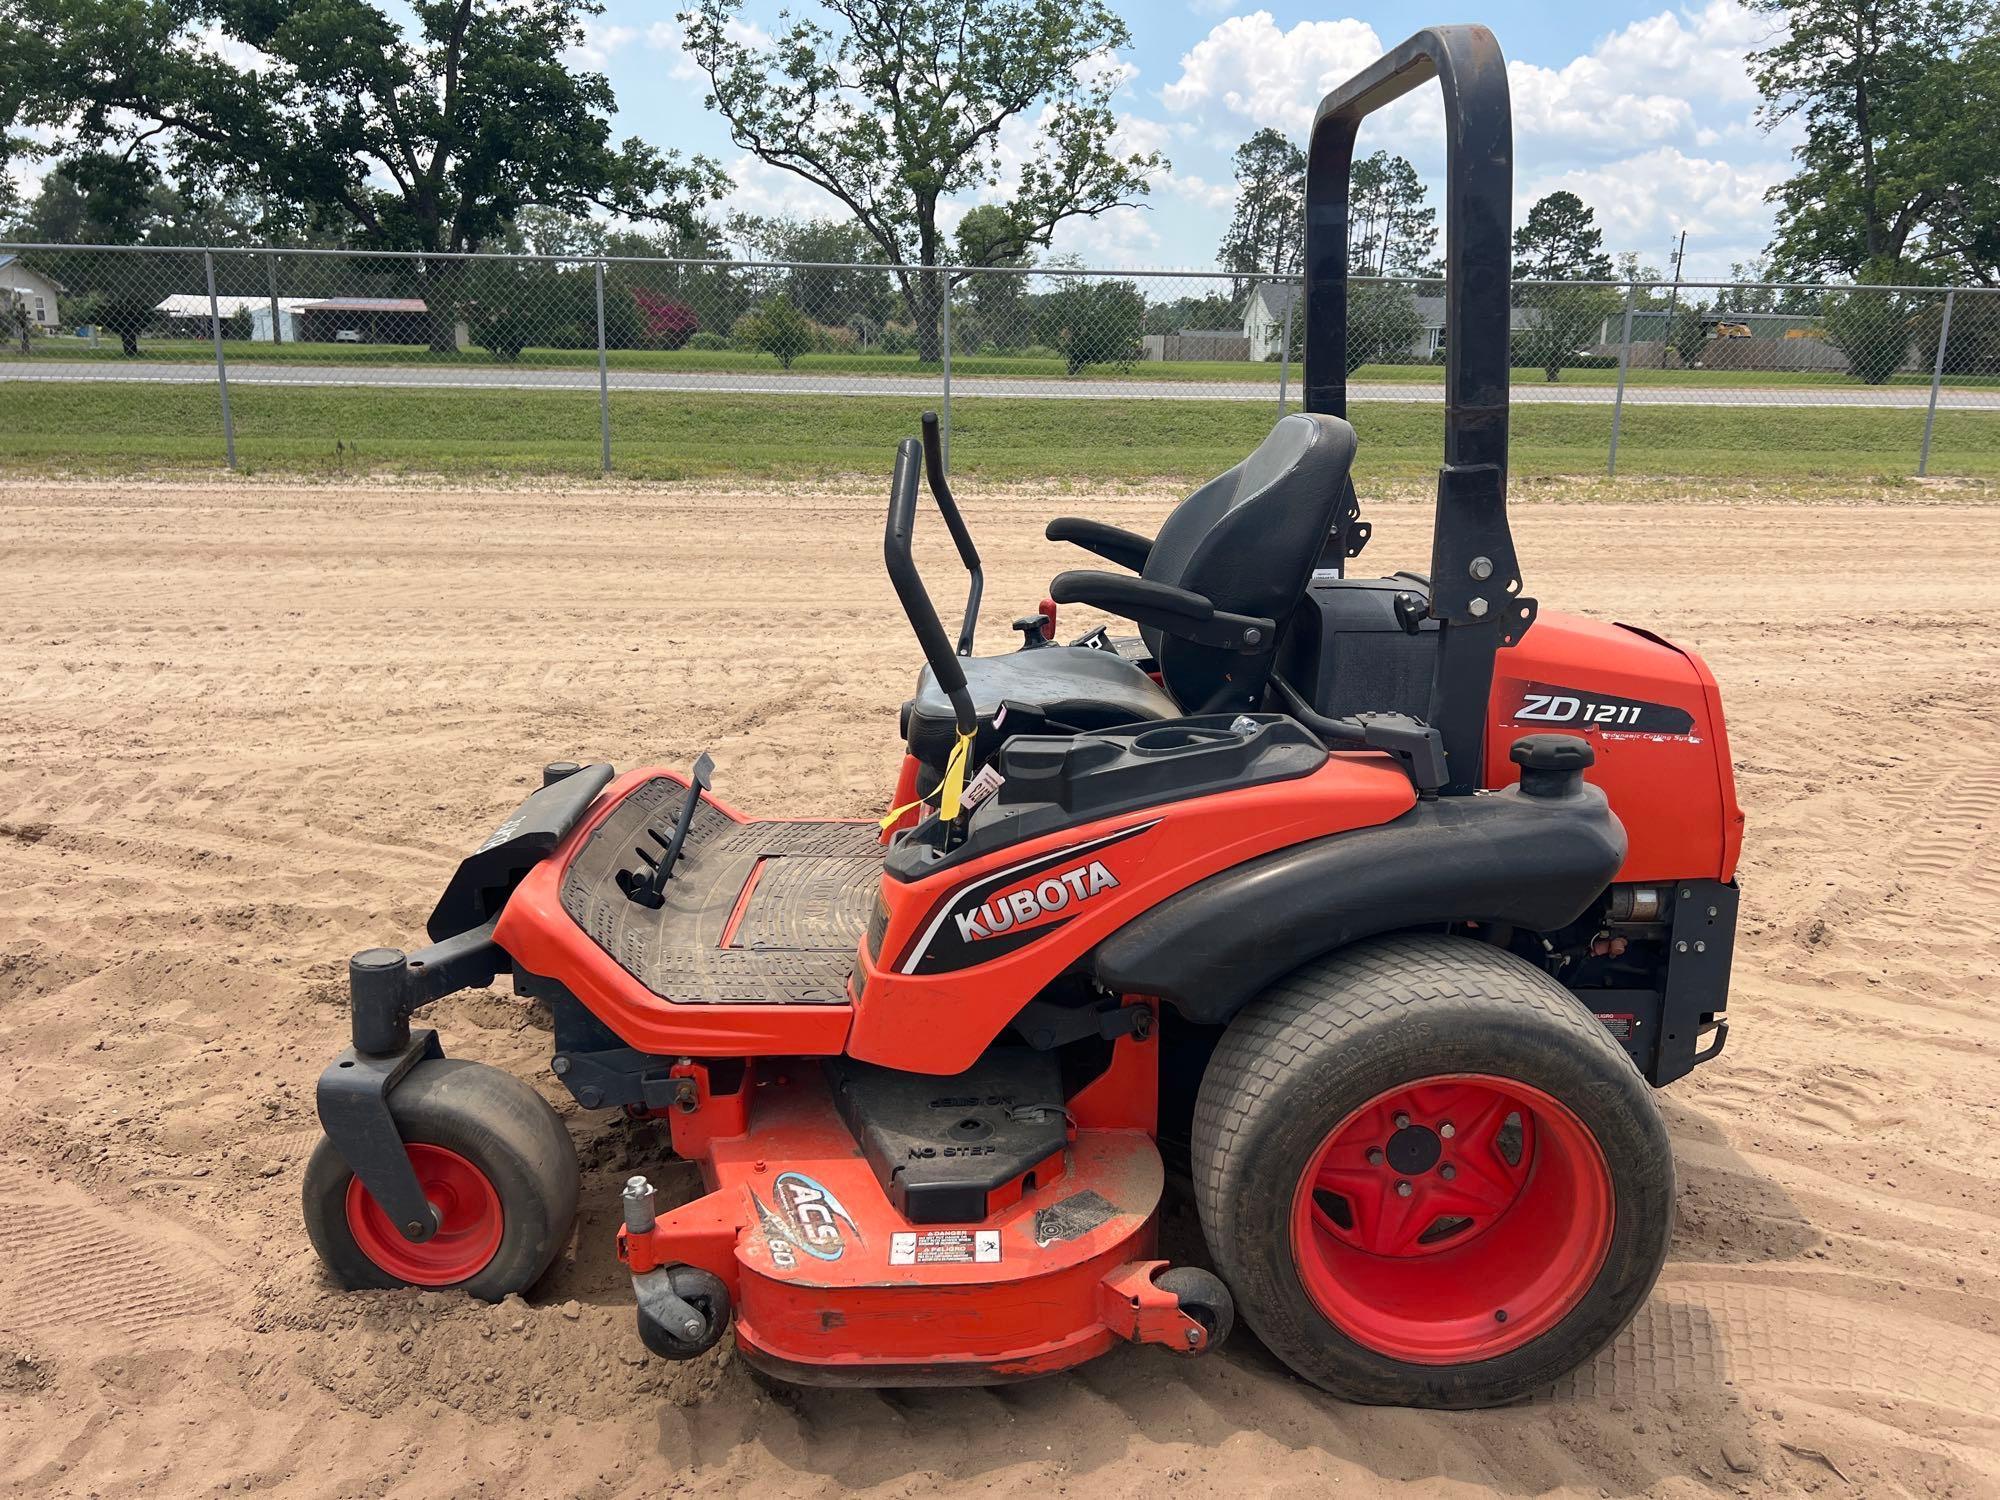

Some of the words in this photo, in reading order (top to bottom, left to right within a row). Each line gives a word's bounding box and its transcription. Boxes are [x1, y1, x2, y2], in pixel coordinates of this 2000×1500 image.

[1513, 694, 1581, 722] ZD
[1583, 704, 1642, 724] 1211
[954, 860, 1121, 944] KUBOTA
[908, 1146, 937, 1159] NO
[943, 1145, 996, 1157] STEP
[787, 1184, 840, 1245] ACS
[768, 1239, 797, 1265] 60
